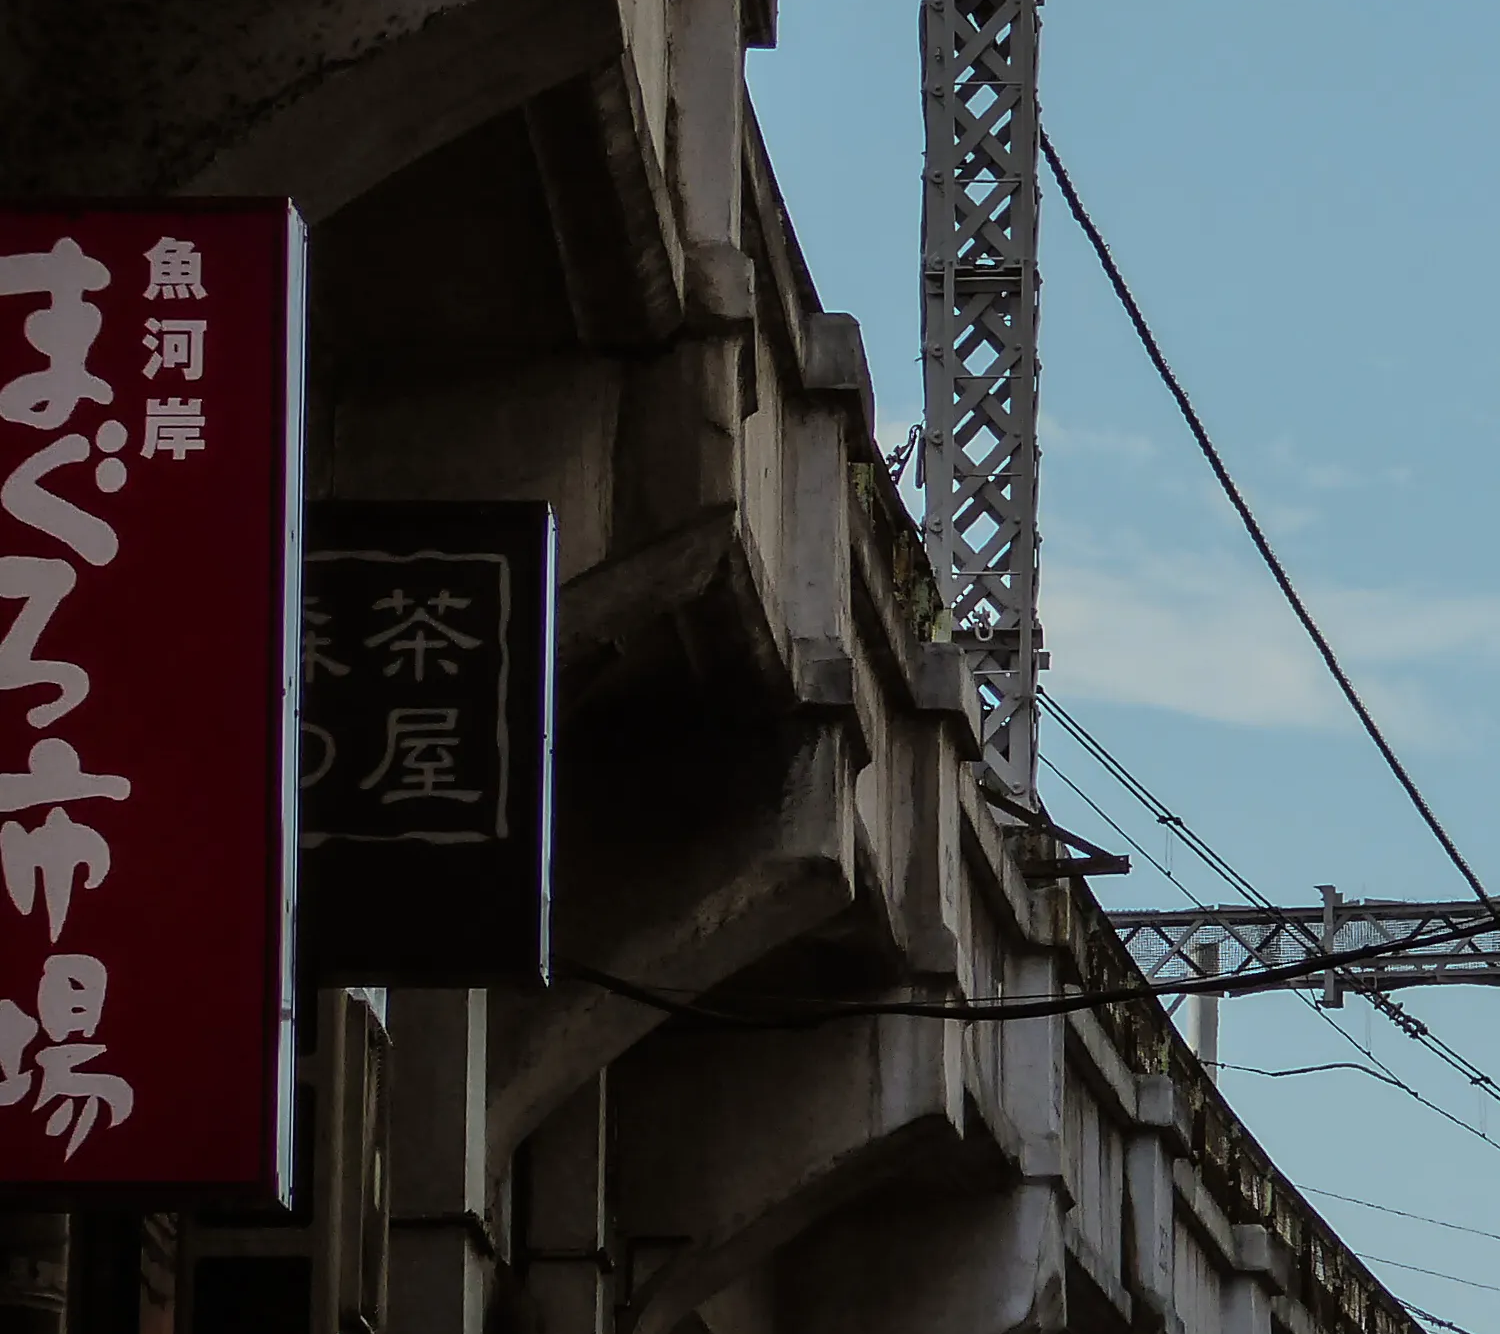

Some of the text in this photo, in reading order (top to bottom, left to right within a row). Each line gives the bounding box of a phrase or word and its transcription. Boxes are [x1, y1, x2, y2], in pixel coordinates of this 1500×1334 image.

[141, 236, 208, 461] 魚河岸
[0, 236, 134, 1162] まぐろ市場
[359, 589, 484, 805] 茶屋
